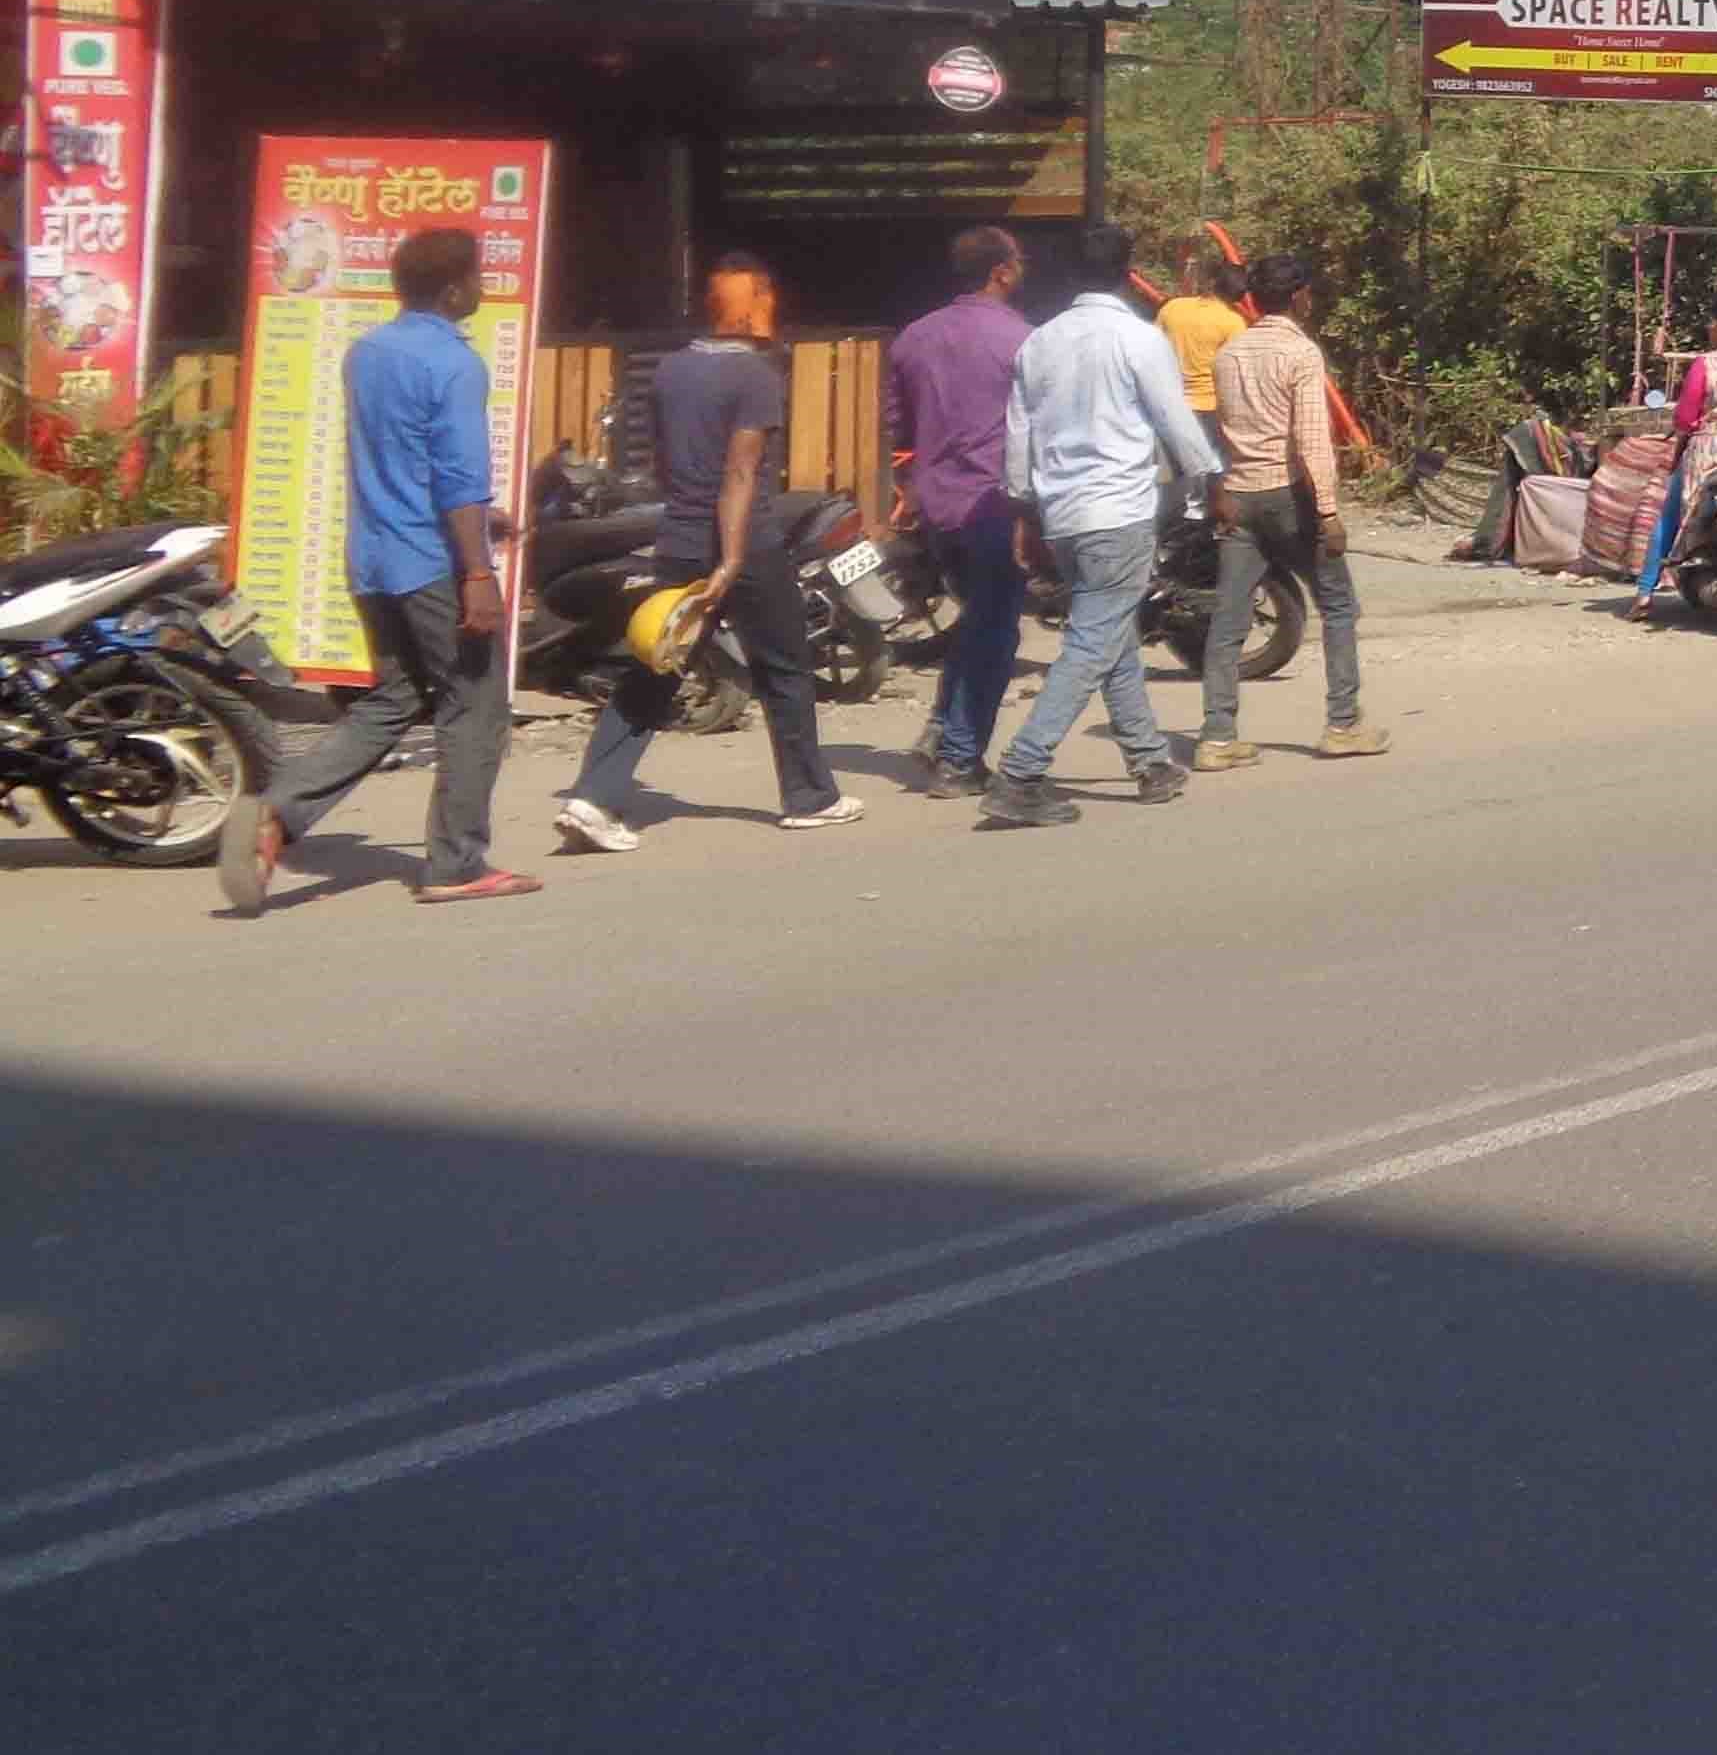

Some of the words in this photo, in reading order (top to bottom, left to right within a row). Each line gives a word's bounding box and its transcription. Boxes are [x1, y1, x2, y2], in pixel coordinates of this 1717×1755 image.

[1553, 52, 1577, 66] BUY
[1602, 53, 1629, 67] SALE
[1655, 56, 1685, 70] RENT
